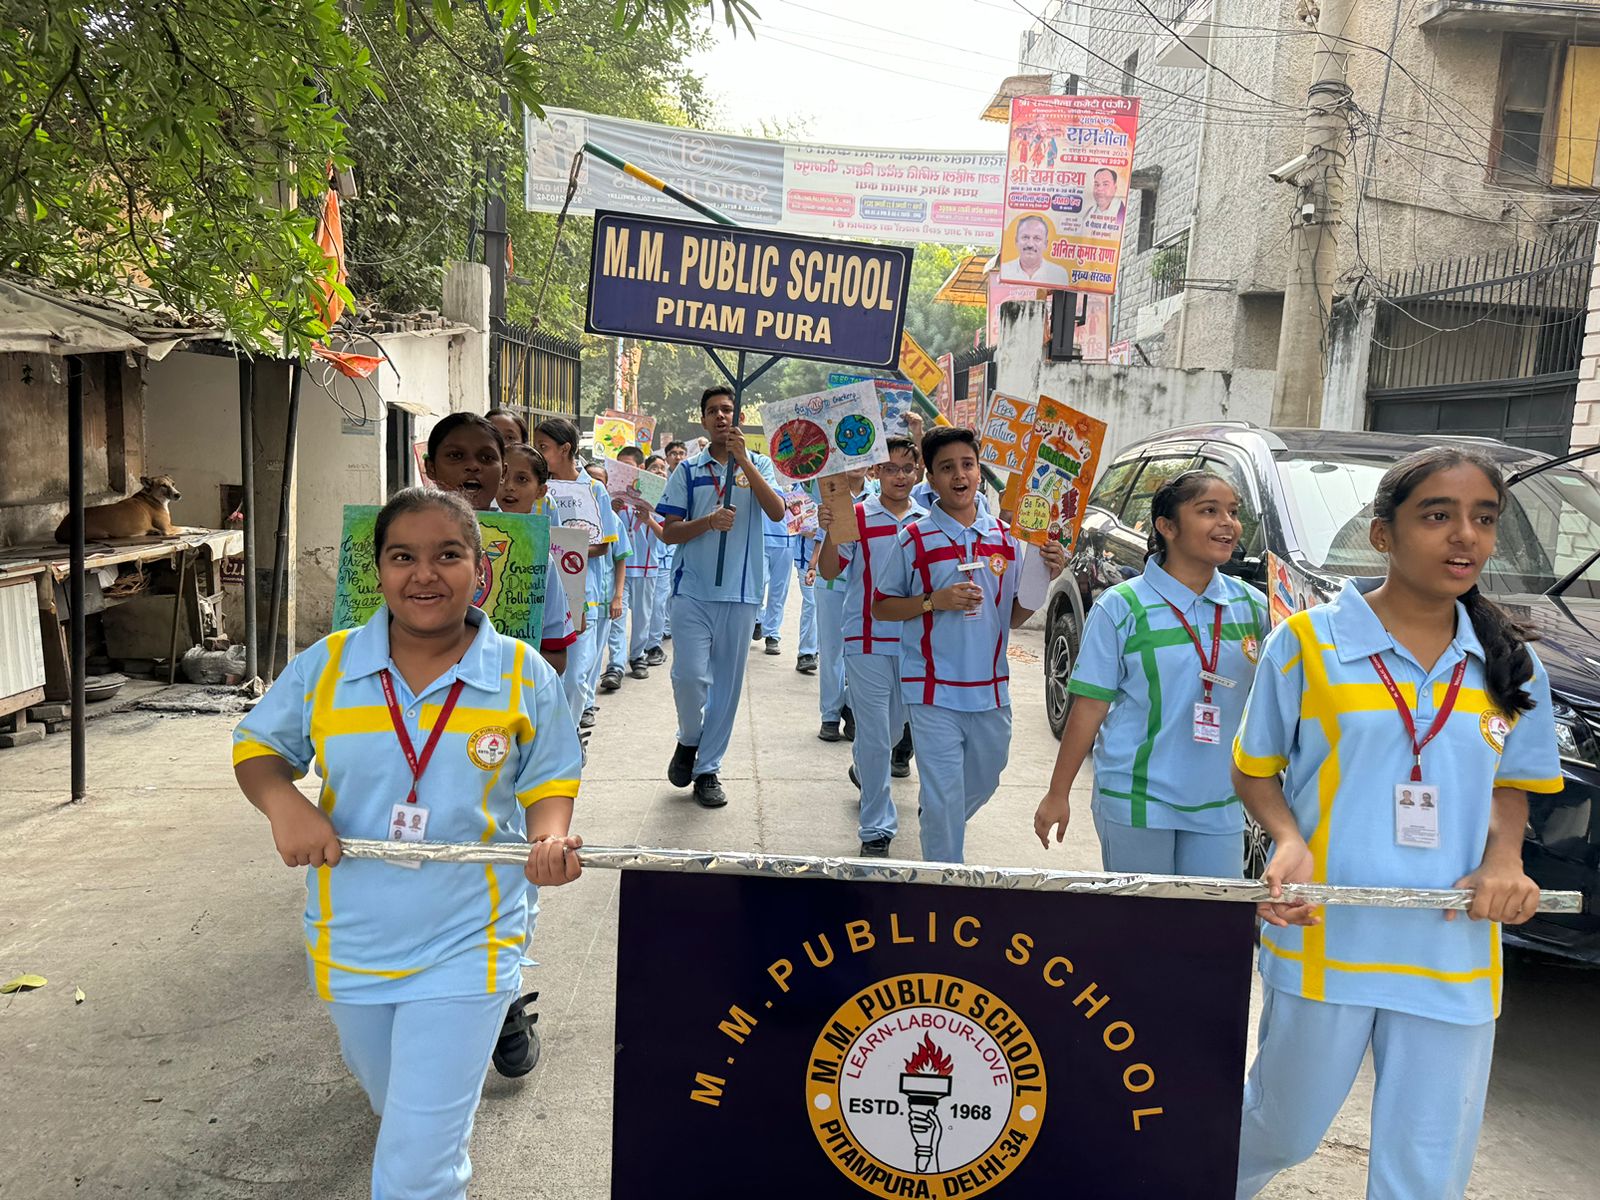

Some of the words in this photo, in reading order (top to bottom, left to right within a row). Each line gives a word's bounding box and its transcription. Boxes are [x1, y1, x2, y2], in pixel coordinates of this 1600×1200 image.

[1030, 169, 1055, 185] राम
[1056, 170, 1087, 186] कथा
[1051, 239, 1076, 259] अनिल
[1076, 244, 1097, 265] कुमार
[1098, 247, 1116, 264] राणा
[602, 226, 671, 284] M.M.
[679, 235, 781, 298] PUBLIC
[788, 248, 895, 312] SCHOOL
[1071, 269, 1089, 283] मुख्य
[1090, 268, 1112, 283] संरक्षक
[656, 296, 746, 336] PITAM
[755, 309, 833, 345] PURA
[901, 341, 935, 380] XIT
[986, 419, 1016, 443] Future
[983, 444, 998, 461] No
[504, 590, 545, 605] Pollution
[494, 618, 536, 639] Diwali
[811, 1020, 861, 1084] M.M.
[856, 978, 964, 1021] PUBLIC
[968, 993, 1042, 1097] SCHOOL
[1005, 932, 1165, 1132] SCHOOL
[848, 1097, 904, 1116] ESTD.
[950, 1103, 992, 1121] 1968
[820, 1118, 937, 1200] PITAMPURA,
[942, 1128, 1029, 1198] DELHI-34
